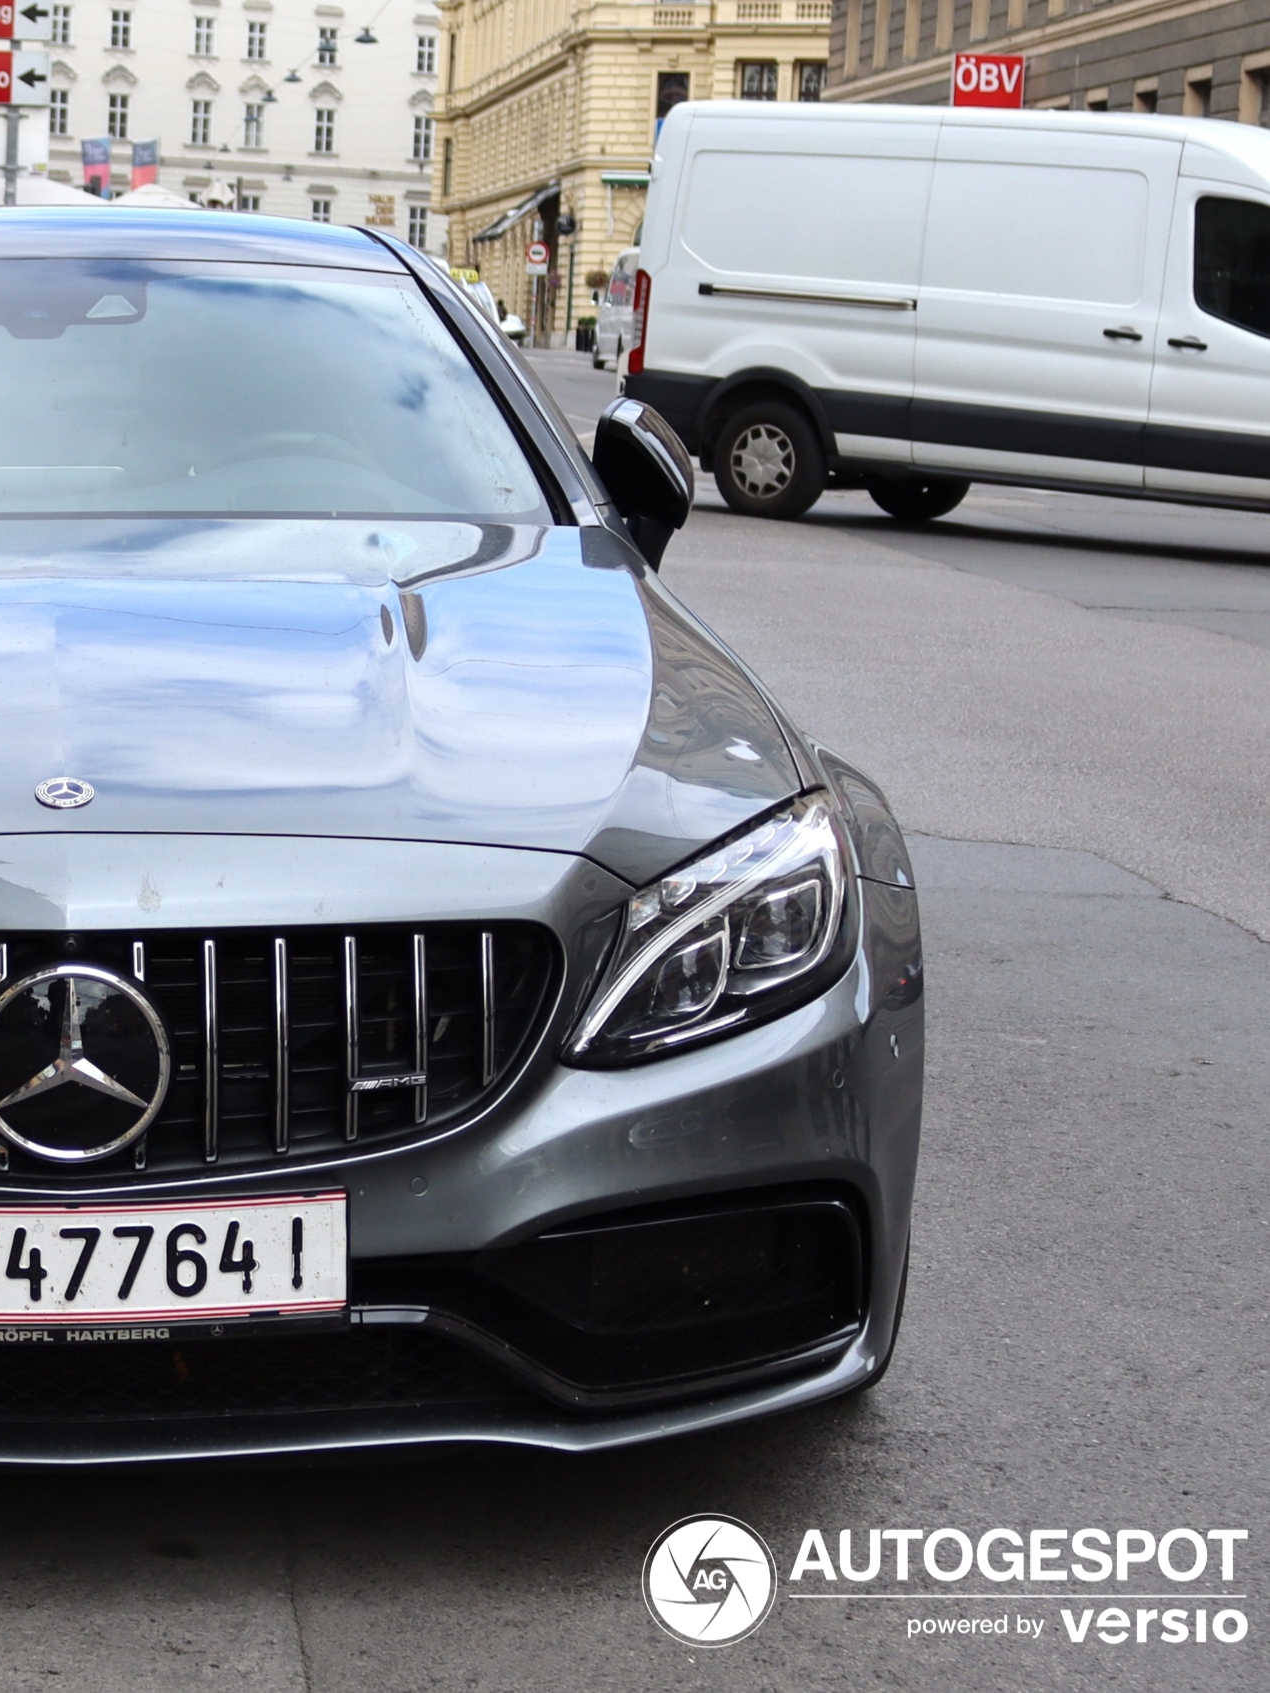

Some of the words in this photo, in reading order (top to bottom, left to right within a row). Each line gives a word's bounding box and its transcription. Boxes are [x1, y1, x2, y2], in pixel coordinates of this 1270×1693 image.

[956, 56, 1021, 93] ÖBV
[375, 1075, 427, 1088] AMG
[66, 1327, 170, 1342] HARTBERG
